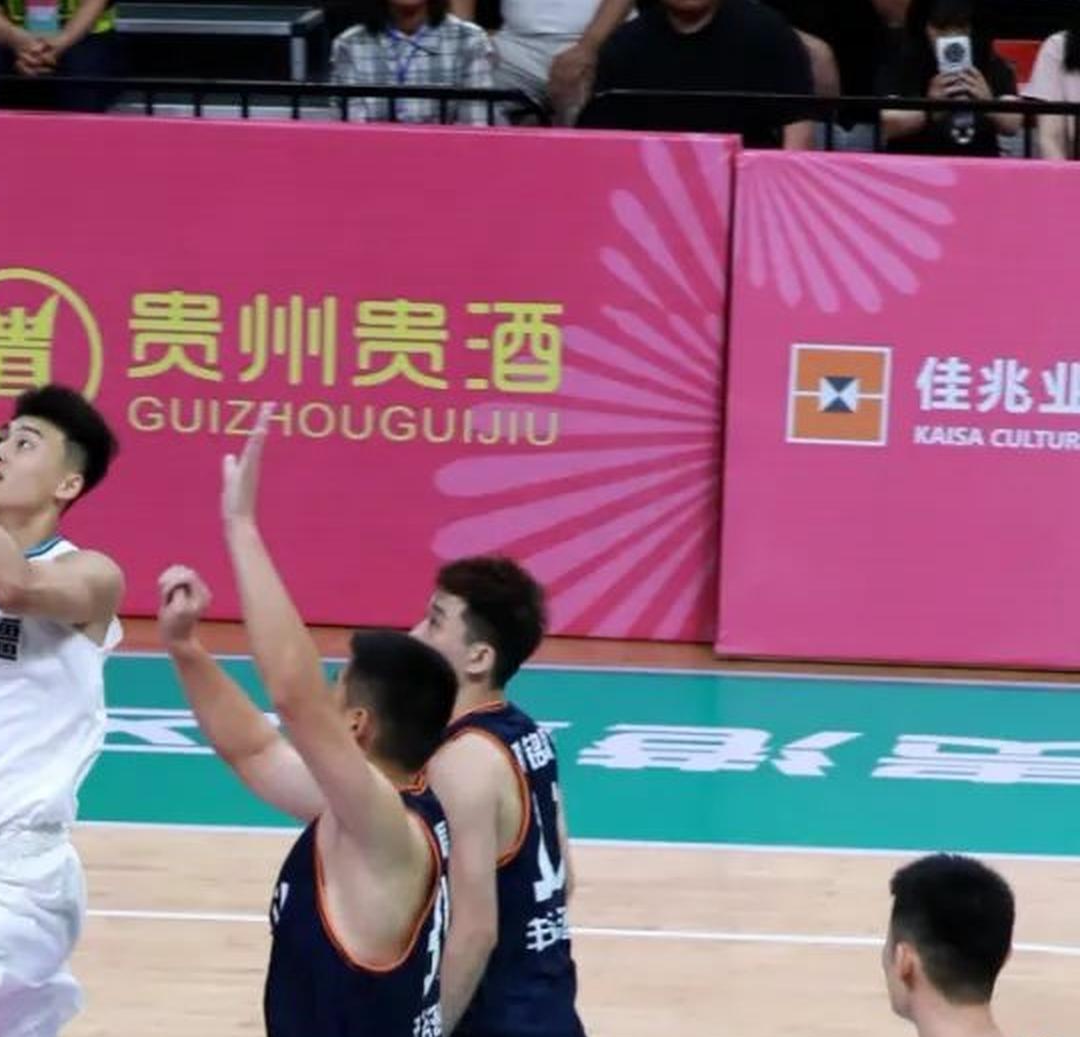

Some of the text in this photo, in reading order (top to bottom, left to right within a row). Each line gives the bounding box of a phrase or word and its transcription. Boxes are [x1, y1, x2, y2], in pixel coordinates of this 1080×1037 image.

[127, 290, 563, 393] 贵州贵酒
[916, 356, 1080, 414] 佳兆业
[127, 396, 559, 446] GUIZHOUGUIJIU
[913, 425, 984, 446] KAISA
